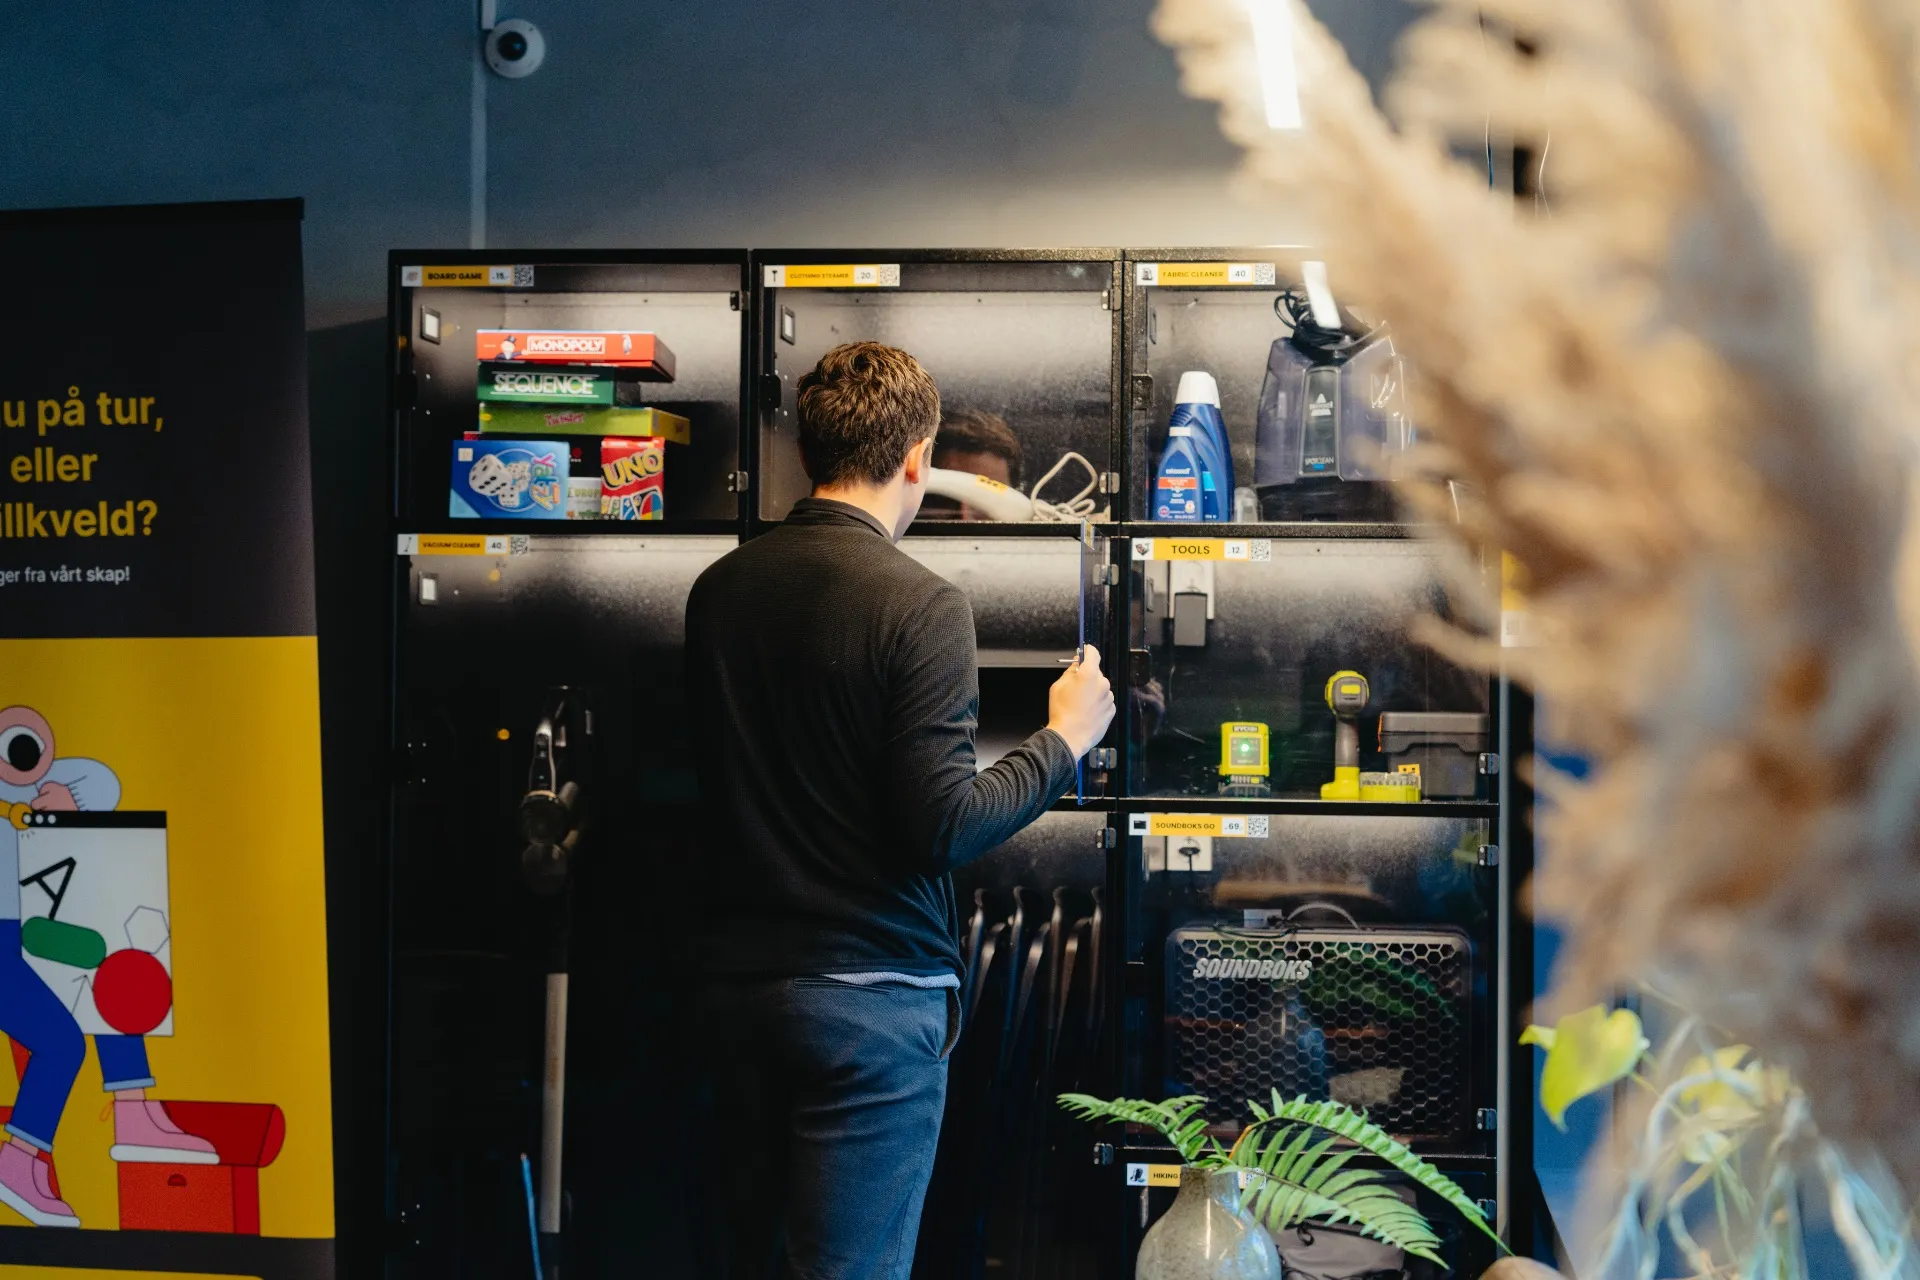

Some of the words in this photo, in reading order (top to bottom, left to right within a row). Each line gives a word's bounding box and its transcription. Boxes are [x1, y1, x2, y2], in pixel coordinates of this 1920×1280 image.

[428, 271, 457, 280] BOARD
[458, 272, 483, 280] GAME
[1235, 270, 1246, 278] 40
[530, 338, 603, 352] MONOPOLY
[494, 373, 593, 395] SEQUENCE
[37, 385, 86, 436] på
[96, 391, 163, 432] tur,
[10, 447, 98, 483] eller
[602, 448, 665, 490] UNO
[423, 541, 451, 549] VACUUM
[1172, 545, 1210, 555] TOOLS
[1231, 545, 1240, 554] 12
[25, 566, 46, 582] fra
[50, 564, 82, 582] vårt
[86, 565, 130, 585] skap!
[1155, 822, 1202, 830] SOUNDBOKS
[1228, 822, 1240, 831] 69
[1192, 957, 1313, 981] SOUNDBOKS
[1152, 1172, 1179, 1180] HIKING
